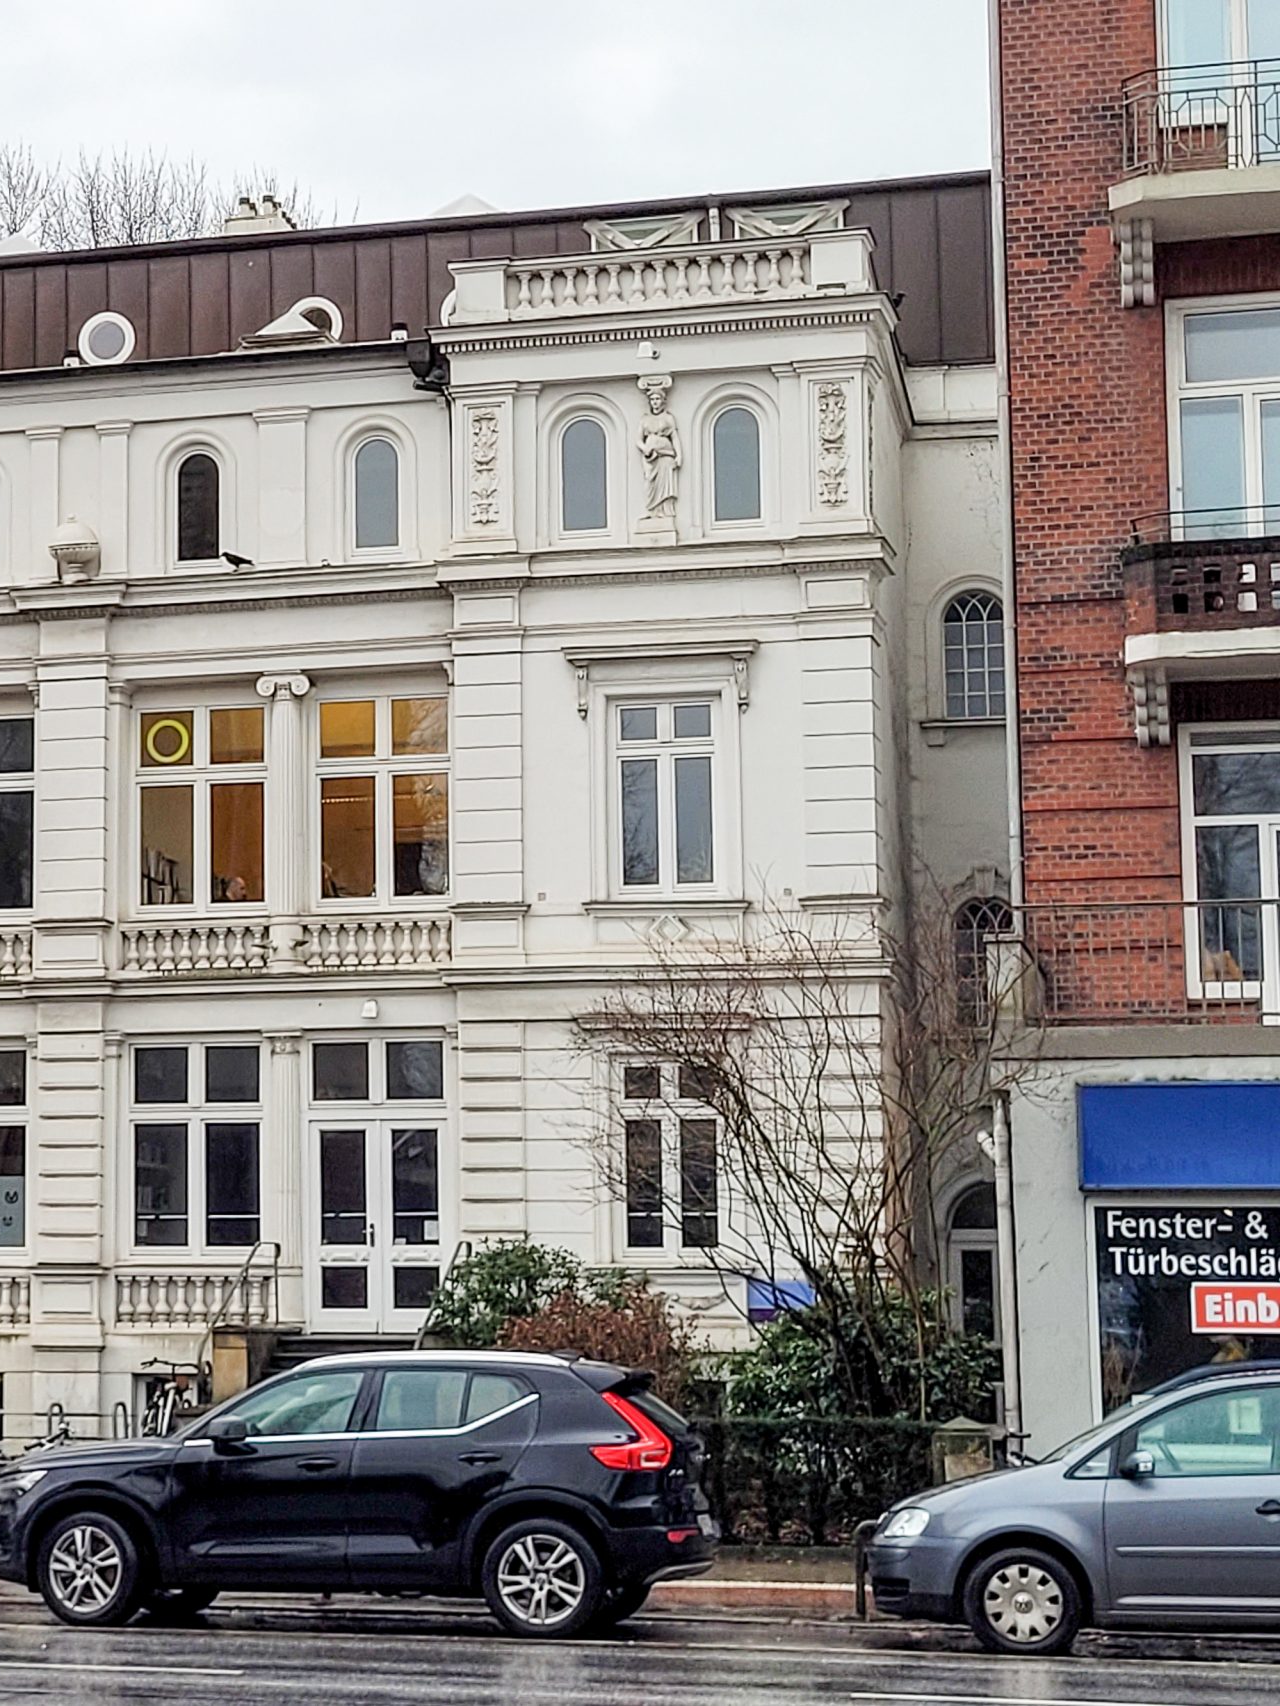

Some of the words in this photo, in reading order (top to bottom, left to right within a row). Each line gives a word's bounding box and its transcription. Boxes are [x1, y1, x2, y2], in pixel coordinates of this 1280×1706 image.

[1106, 1210, 1233, 1240] Fenster-
[1244, 1210, 1269, 1240] &
[1107, 1246, 1280, 1279] Türbeschlä
[1204, 1292, 1280, 1324] Einb
